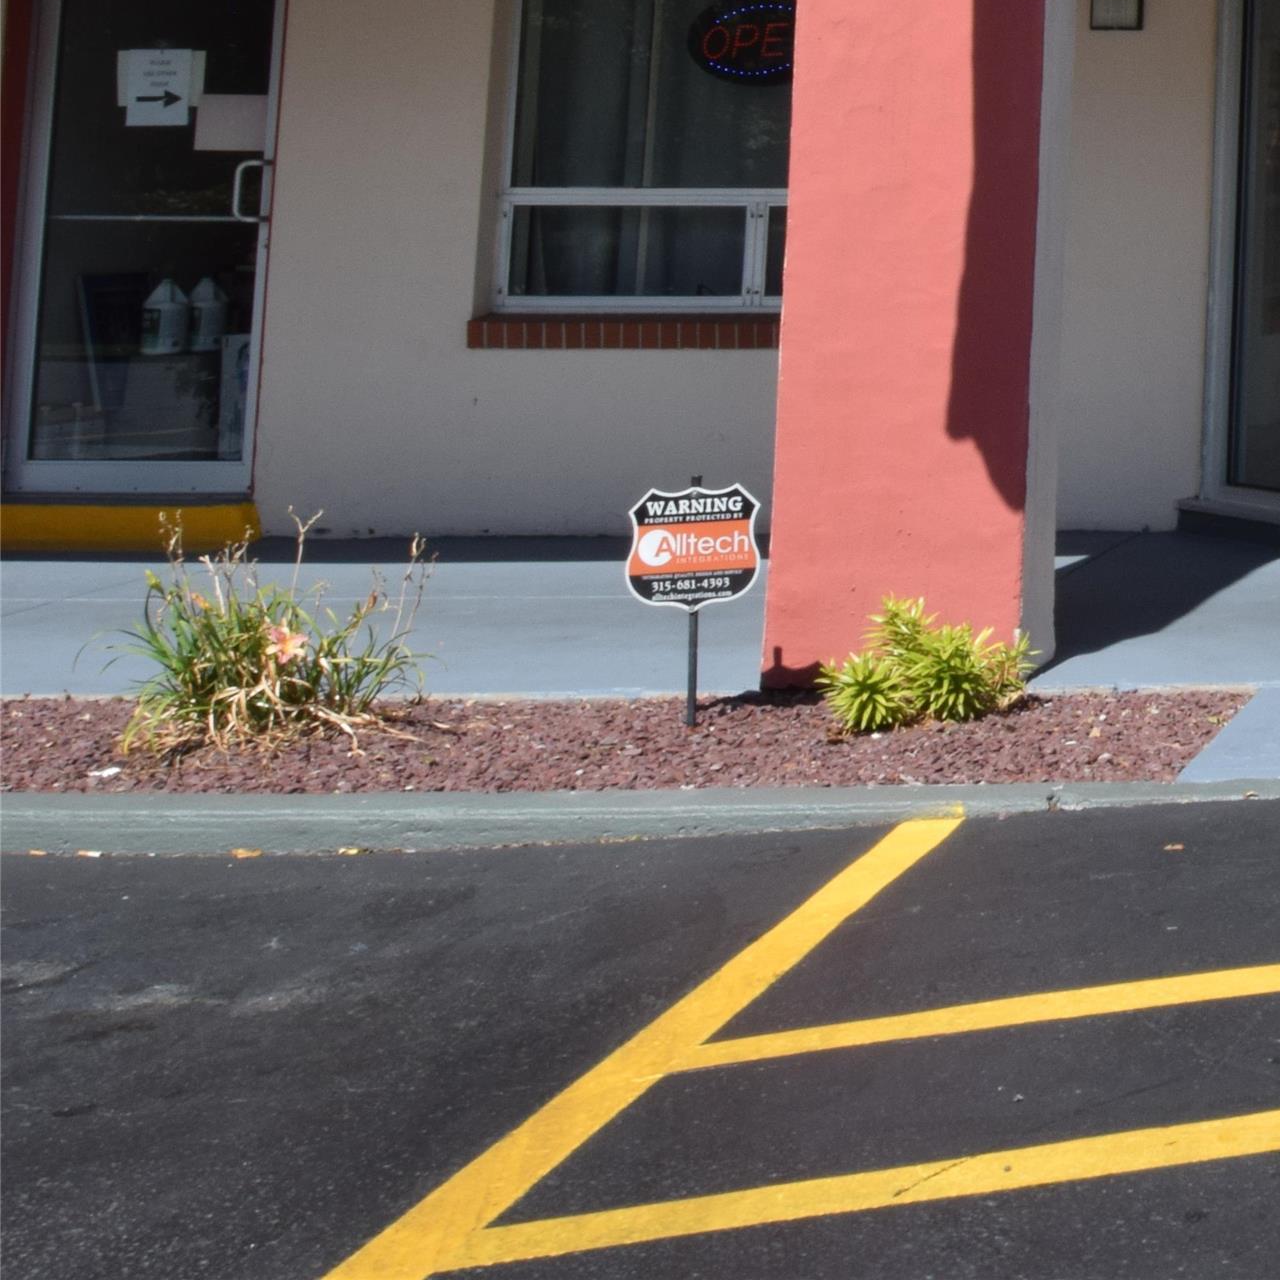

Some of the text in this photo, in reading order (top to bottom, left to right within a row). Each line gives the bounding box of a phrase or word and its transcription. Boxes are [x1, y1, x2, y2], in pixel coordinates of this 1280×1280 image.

[703, 23, 790, 60] OPE
[645, 496, 744, 517] WARNING
[644, 516, 683, 524] PROPERTY
[685, 513, 732, 522] PROTECTED
[648, 530, 750, 560] Alltech
[676, 553, 749, 564] INTEGRATIONS
[651, 577, 731, 593] 315-681-4393
